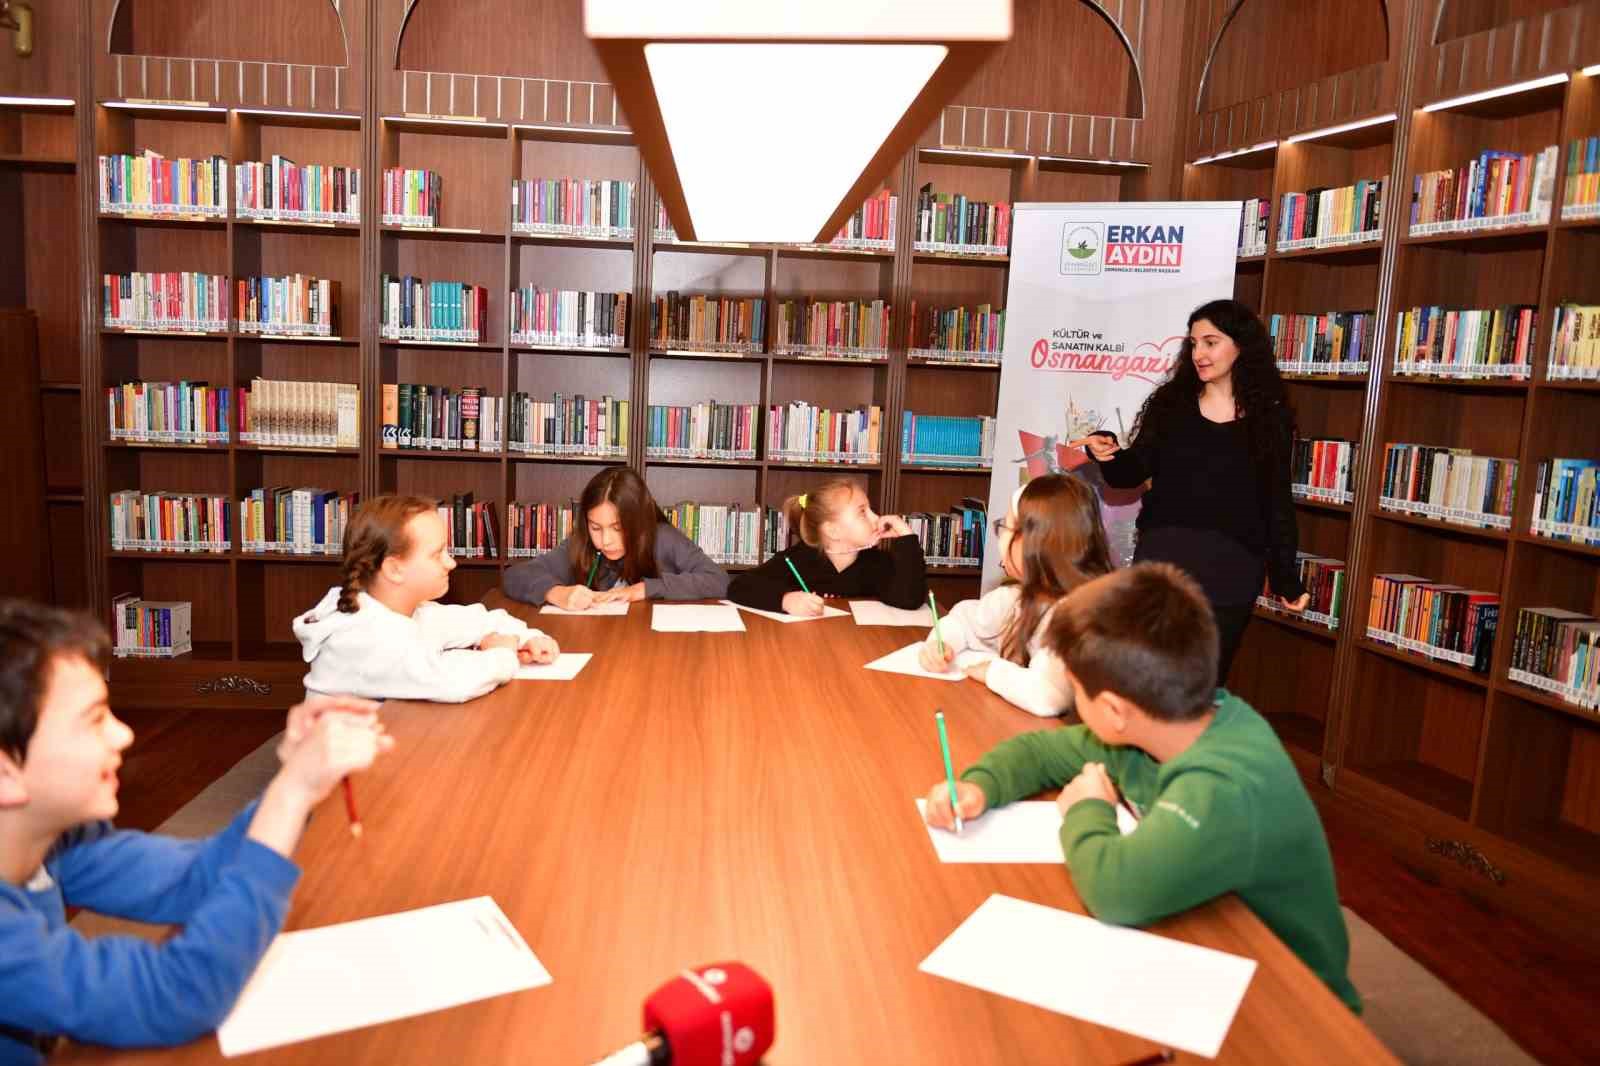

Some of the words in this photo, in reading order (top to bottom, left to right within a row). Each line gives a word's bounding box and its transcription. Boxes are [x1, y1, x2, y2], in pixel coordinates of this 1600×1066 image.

[1107, 225, 1184, 243] ERKAN
[1109, 245, 1178, 265] AYDIN
[1052, 328, 1089, 339] KÜLTÜR
[1052, 342, 1094, 351] SANATIN
[1096, 342, 1125, 352] KALBİ
[1031, 338, 1172, 381] Osmangazi
